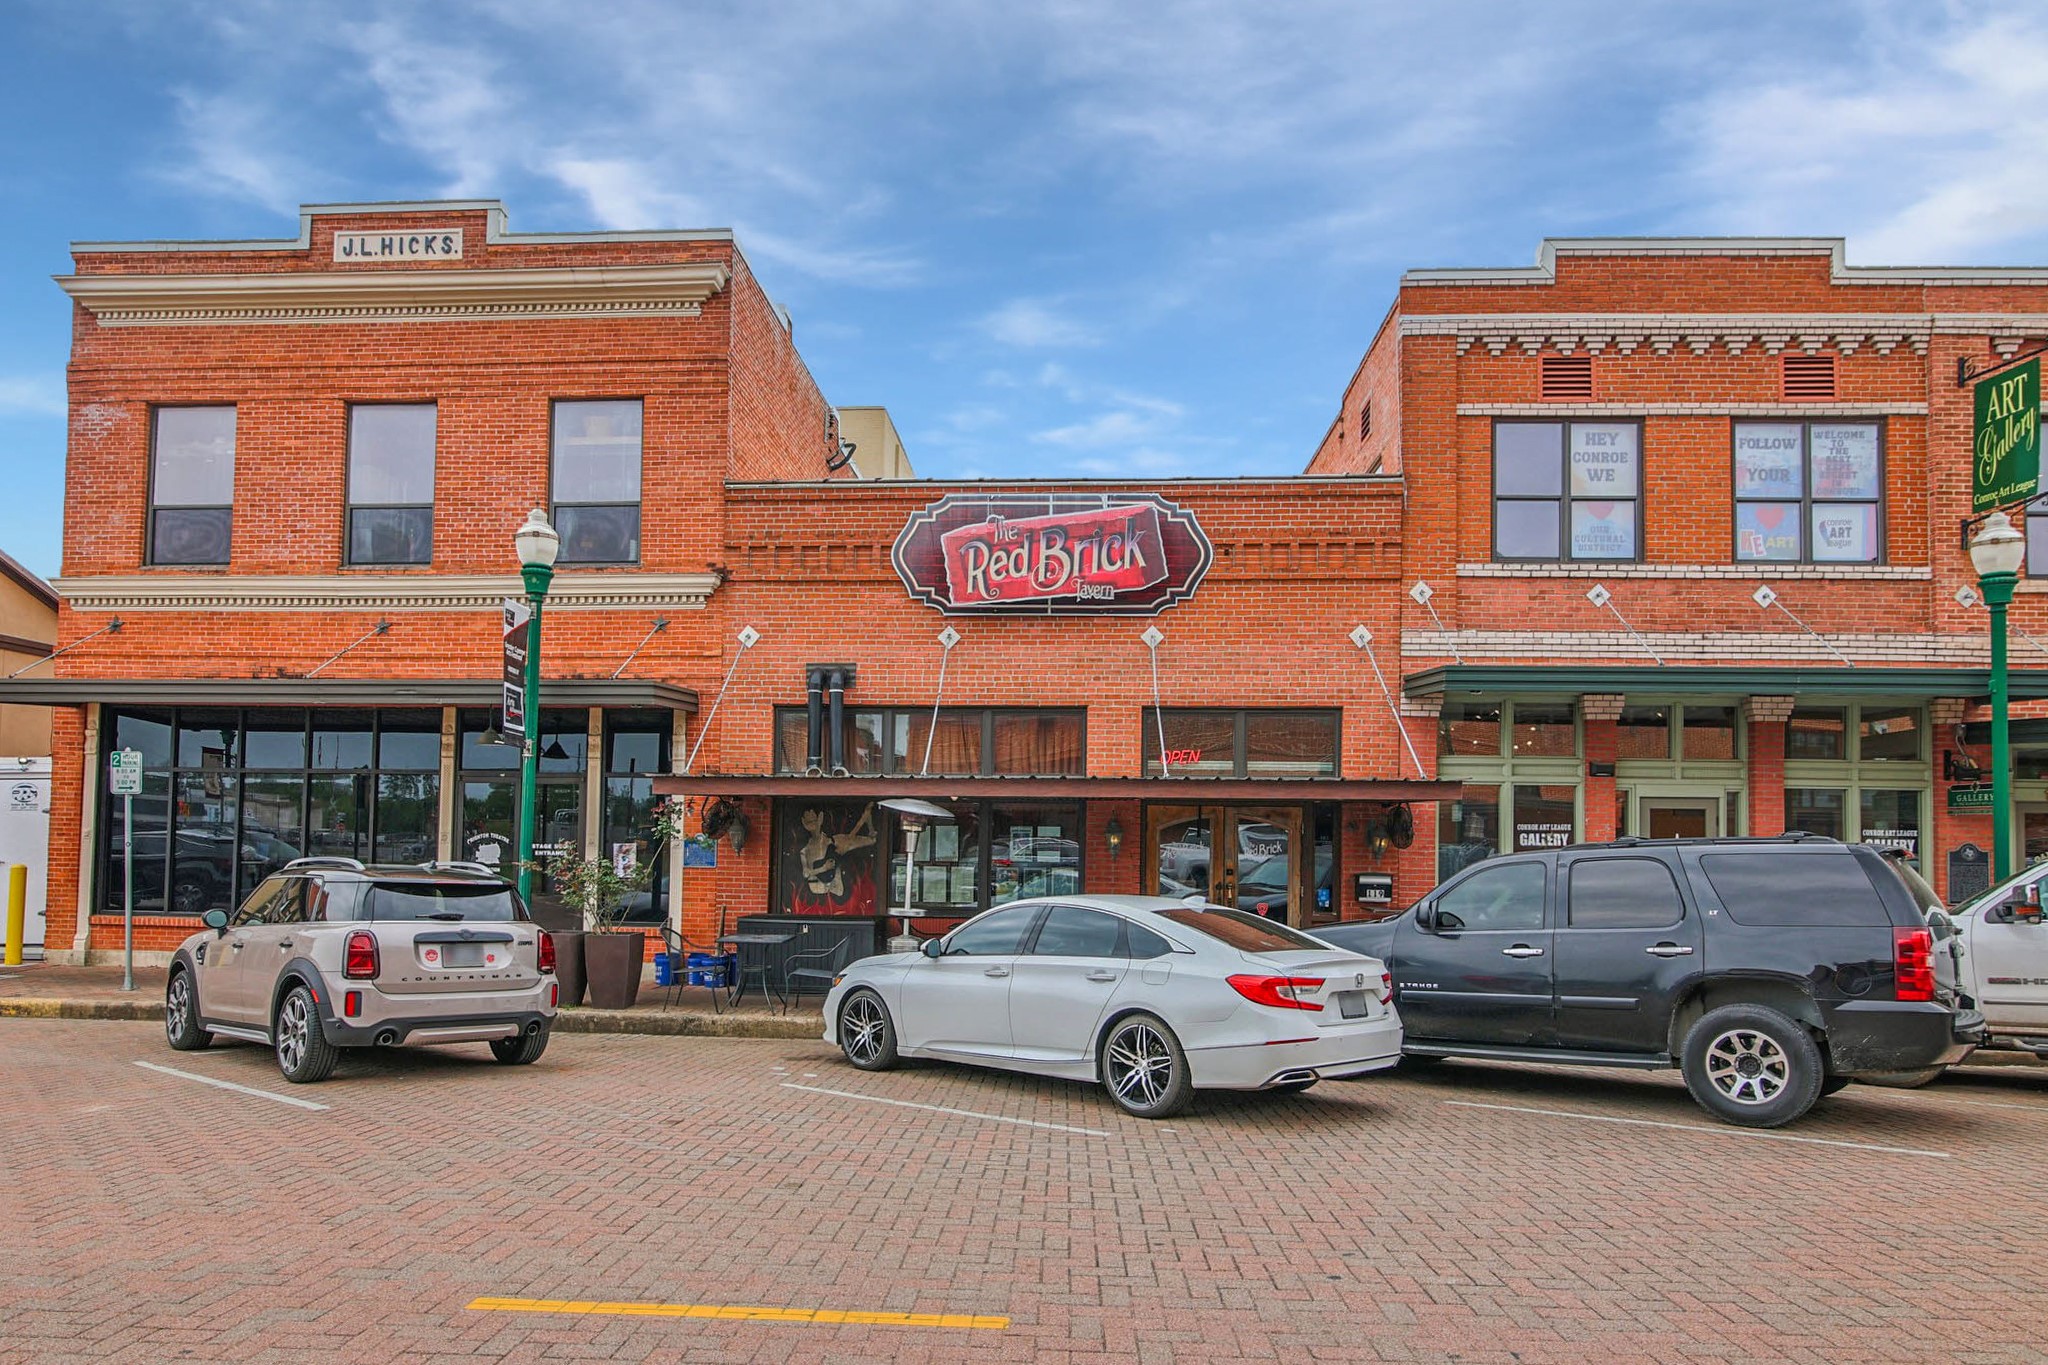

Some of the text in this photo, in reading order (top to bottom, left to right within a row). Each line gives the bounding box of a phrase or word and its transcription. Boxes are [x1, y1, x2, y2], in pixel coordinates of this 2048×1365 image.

[1986, 373, 2028, 424] ART
[1585, 432, 1619, 446] HEY
[1814, 431, 1865, 439] WELCOME
[1738, 438, 1796, 450] FOLLOW
[1977, 407, 2036, 486] Gallery
[1573, 452, 1629, 463] CONROE
[1587, 468, 1615, 482] WE
[1746, 468, 1790, 482] YOUR
[1974, 479, 2037, 505] Conroe Art League
[986, 514, 1018, 542] The
[1590, 525, 1609, 533] OUR
[1830, 527, 1852, 538] ART
[1575, 535, 1625, 543] CULTURAL
[959, 517, 1148, 599] Red Brick
[1074, 577, 1114, 601] Tavern
[113, 755, 120, 765] 2
[1160, 749, 1200, 764] OPEN
[1956, 794, 1993, 802] GALLERY
[1520, 833, 1568, 846] GALLERY
[401, 973, 522, 982] COUNTRYMAN
